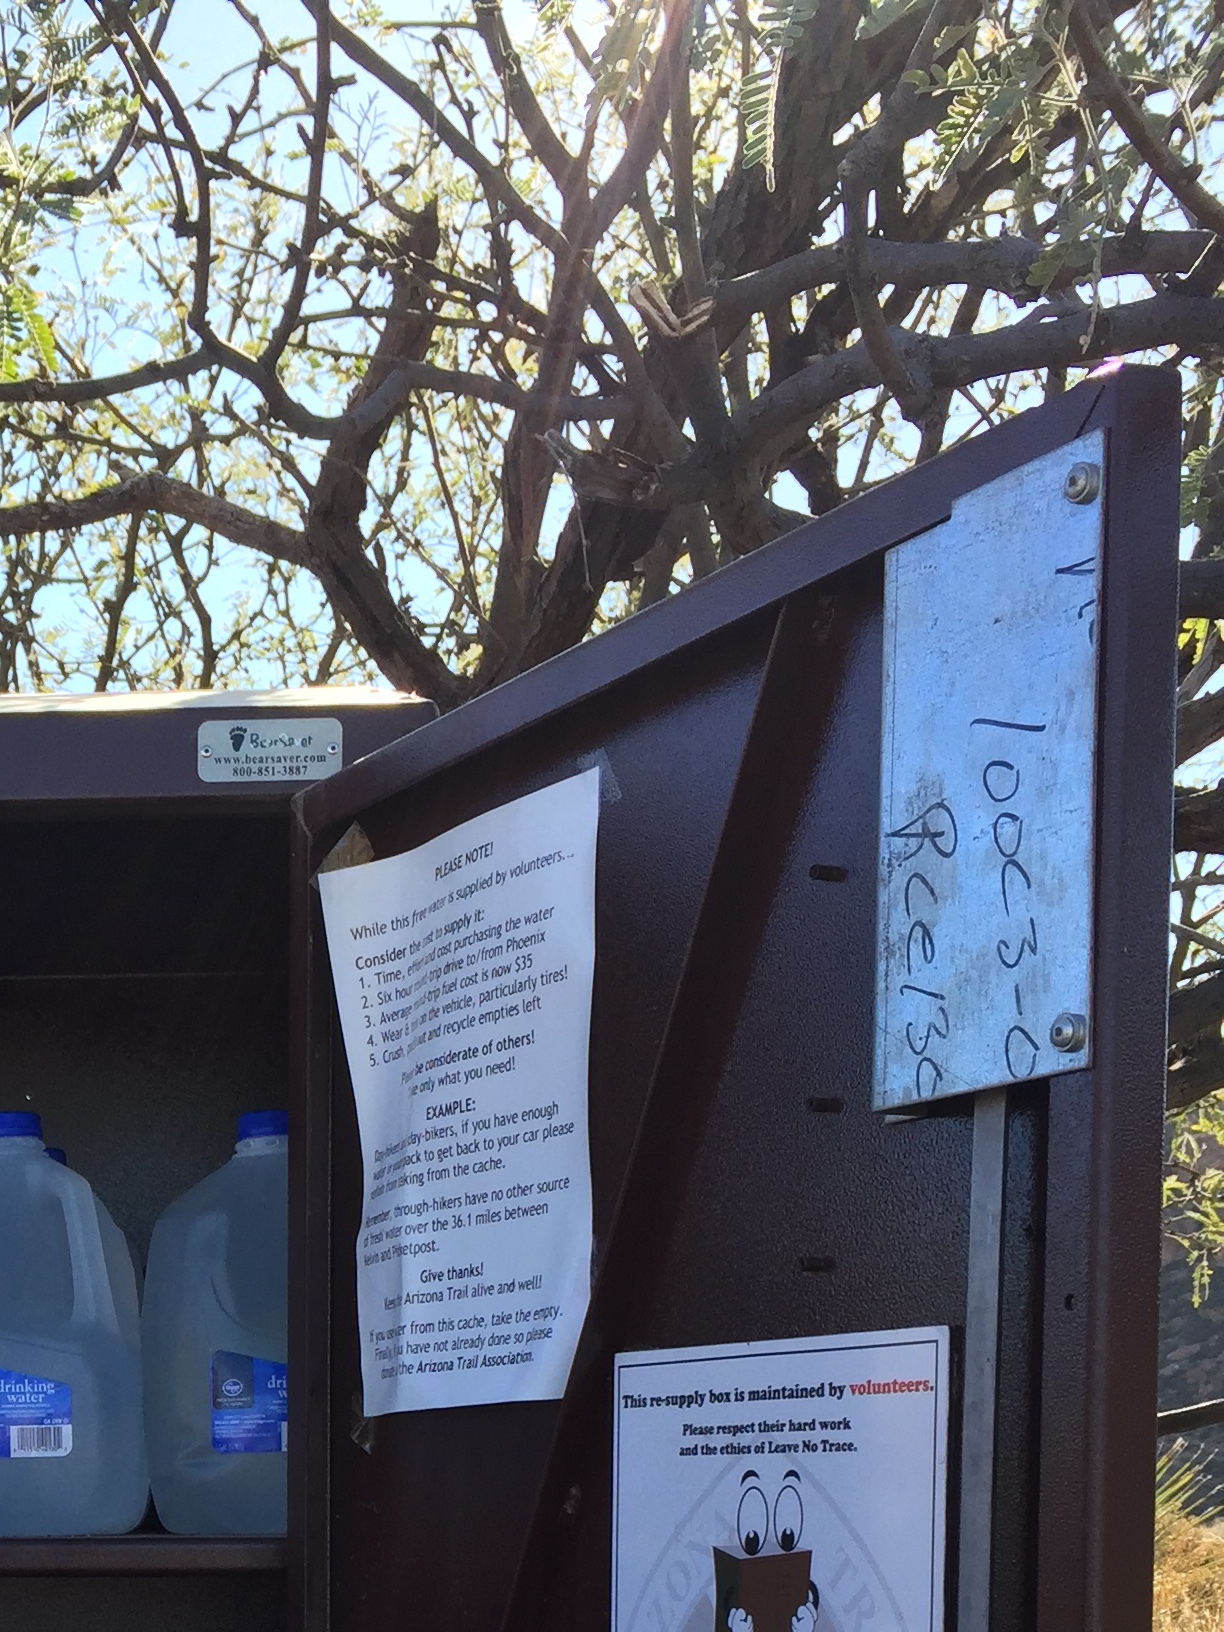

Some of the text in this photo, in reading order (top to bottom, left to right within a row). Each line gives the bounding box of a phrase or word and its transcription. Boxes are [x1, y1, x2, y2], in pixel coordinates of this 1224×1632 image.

[214, 753, 327, 765] www.bearsaver.com
[232, 765, 308, 777] 800-851-3887
[434, 841, 494, 881] PLEASE NOTE!
[349, 870, 507, 941] While this supplied by
[454, 906, 555, 955] purchasing the water
[355, 947, 407, 971] Consider
[376, 990, 393, 1006] Six
[506, 930, 546, 953] Phoenix
[460, 972, 479, 989] cost
[491, 962, 512, 980] now
[515, 953, 533, 973] $35
[479, 964, 568, 1007] particularly tires!
[443, 1014, 476, 1036] recycle
[478, 1003, 520, 1025] empties
[522, 995, 541, 1014] left
[425, 1028, 535, 1072] considerate of others!
[437, 1055, 516, 1087] what you need!
[426, 1097, 476, 1121] EXAMPLE:
[472, 1101, 559, 1136] you have enough
[424, 1149, 435, 1163] to
[437, 1145, 454, 1163] get
[456, 1138, 480, 1156] back
[483, 1137, 494, 1151] to
[497, 1132, 520, 1152] your
[522, 1128, 539, 1143] car
[542, 1121, 575, 1143] please
[426, 1156, 506, 1183] from the cache.
[464, 1176, 570, 1207] have no other source
[404, 1201, 549, 1236] over the 36.1 miles between
[420, 1261, 484, 1283] Give thanks!
[403, 1289, 444, 1306] Arizona
[446, 1283, 469, 1301] Trail
[471, 1281, 495, 1299] alive
[497, 1278, 516, 1295] and
[517, 1274, 543, 1291] well!
[409, 1320, 435, 1335] from
[437, 1317, 455, 1333] this
[457, 1314, 488, 1331] cache,
[491, 1310, 513, 1326] take
[515, 1308, 531, 1323] the
[406, 1341, 431, 1355] have
[433, 1341, 449, 1353] not
[451, 1333, 486, 1351] already
[487, 1332, 511, 1347] done
[513, 1332, 525, 1345] so
[416, 1357, 455, 1375] Arizona
[457, 1353, 479, 1371] Trail
[6, 1392, 46, 1404] water
[622, 1379, 935, 1409] This re-supply box is maintained by volunteers.
[682, 1417, 852, 1437] Please respect their hard work
[679, 1439, 858, 1456] and the ethics of Leave No Trace.
